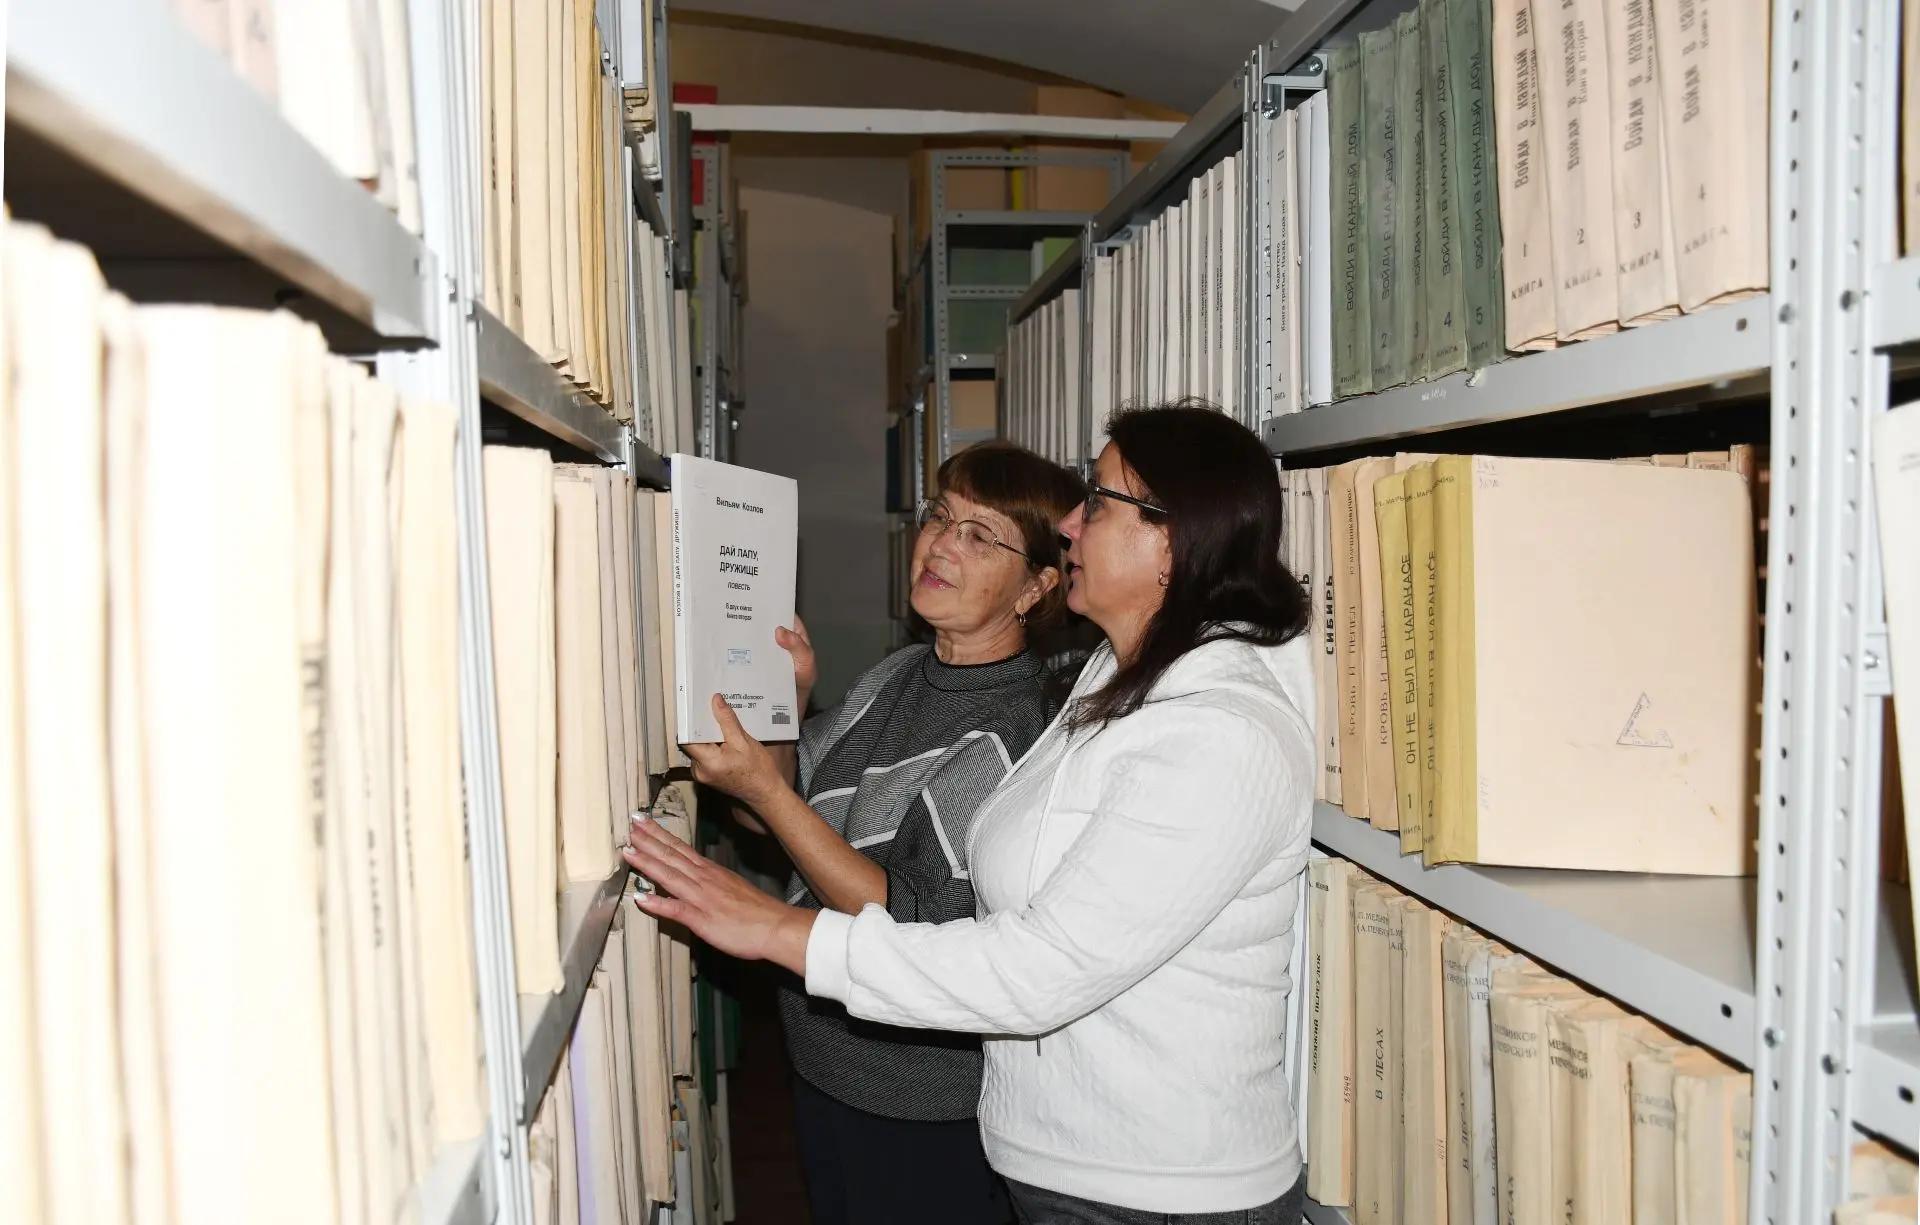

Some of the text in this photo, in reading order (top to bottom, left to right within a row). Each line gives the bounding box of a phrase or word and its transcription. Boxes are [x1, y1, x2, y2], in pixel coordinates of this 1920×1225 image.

[1515, 8, 1528, 38] дом
[1436, 64, 1447, 103] ДОМ
[1469, 51, 1482, 91] ДОМ
[1514, 49, 1529, 110] каждый
[1623, 97, 1644, 152] Войди
[1347, 121, 1358, 156] ДОМ
[1514, 139, 1530, 189] Войди
[1633, 211, 1641, 230] 3
[1577, 228, 1585, 245] 2
[1522, 242, 1527, 258] 1
[1617, 249, 1660, 276] КНИГА
[1345, 258, 1355, 312] ВОЙДИ
[1511, 277, 1543, 301] КНИГА
[1443, 311, 1452, 328] 4
[716, 496, 764, 514] Вильям Козлов
[720, 545, 736, 557] ДАЙ
[720, 561, 759, 577] ДРУЖИЩЕ
[1326, 575, 1335, 656] СИБИРЬ
[1404, 648, 1414, 661] В
[1348, 606, 1356, 736] КРОВЬ И ПЕПЕЛ
[1380, 672, 1388, 683] И
[1404, 665, 1415, 705] БЫЛ
[1380, 692, 1388, 745] КРОВЬ
[1406, 711, 1416, 734] НЕ
[1405, 741, 1416, 765] ОН
[1427, 746, 1435, 771] ОН
[1407, 793, 1412, 809] 1
[1375, 1027, 1385, 1101] В ЛЕСАХ
